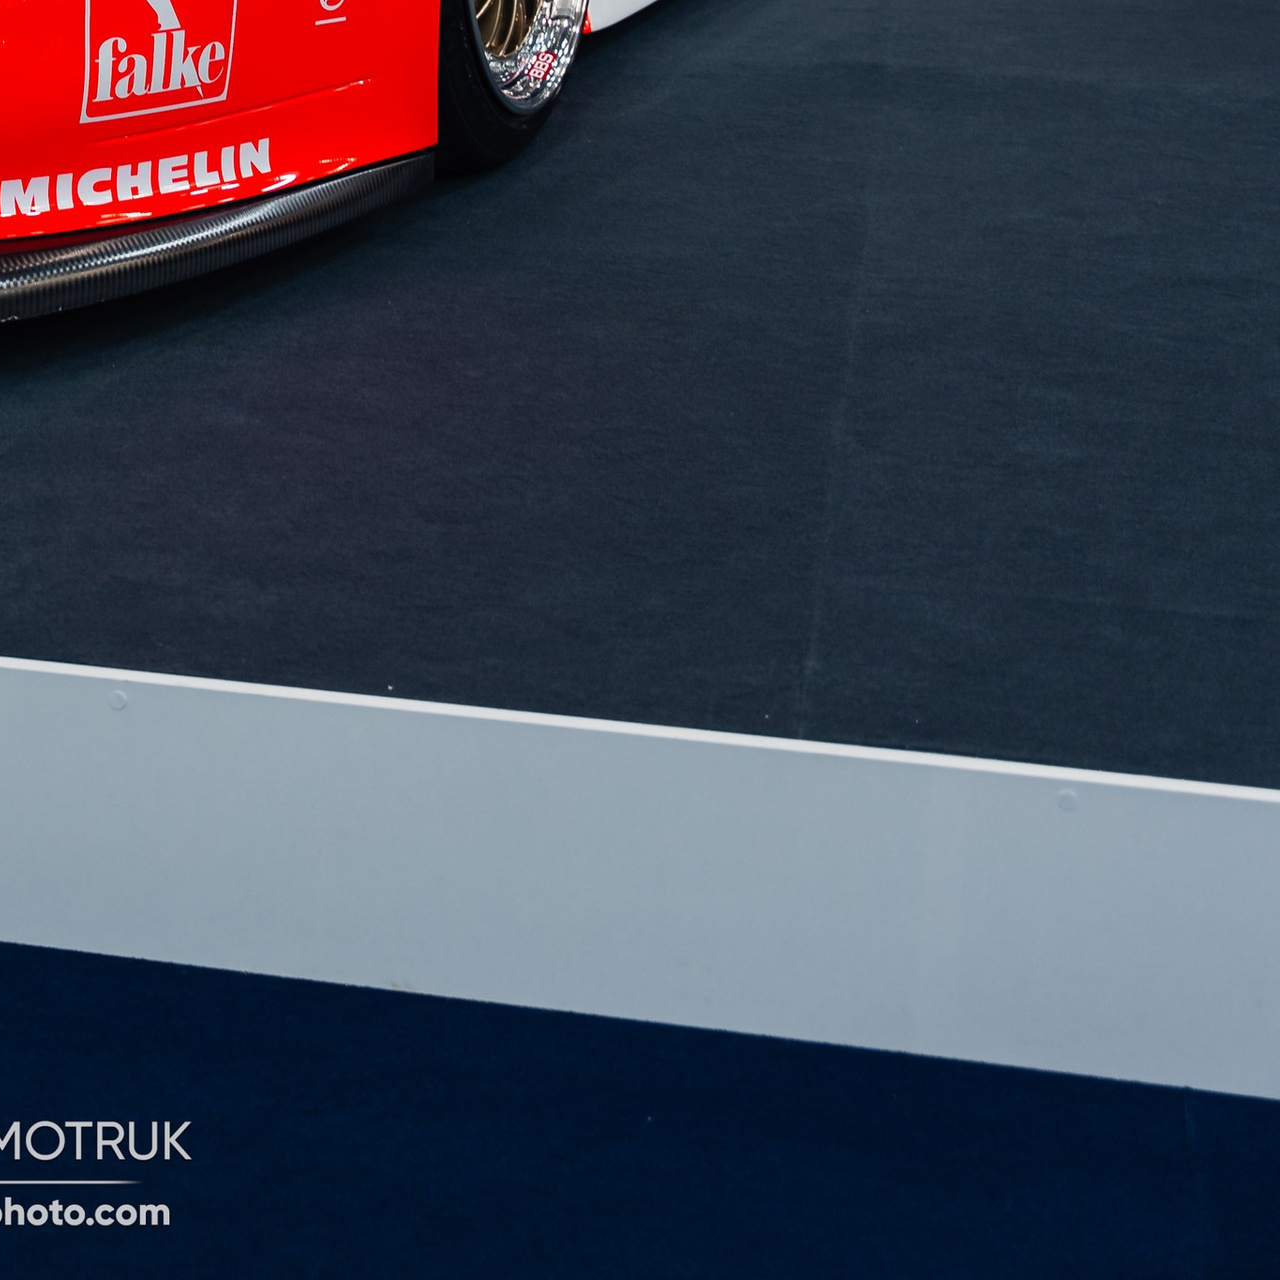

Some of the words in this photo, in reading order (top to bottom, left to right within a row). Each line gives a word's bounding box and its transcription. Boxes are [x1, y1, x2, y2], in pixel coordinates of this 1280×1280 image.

[91, 27, 227, 106] falke
[528, 52, 554, 80] BBS
[0, 138, 271, 217] MICHELIN
